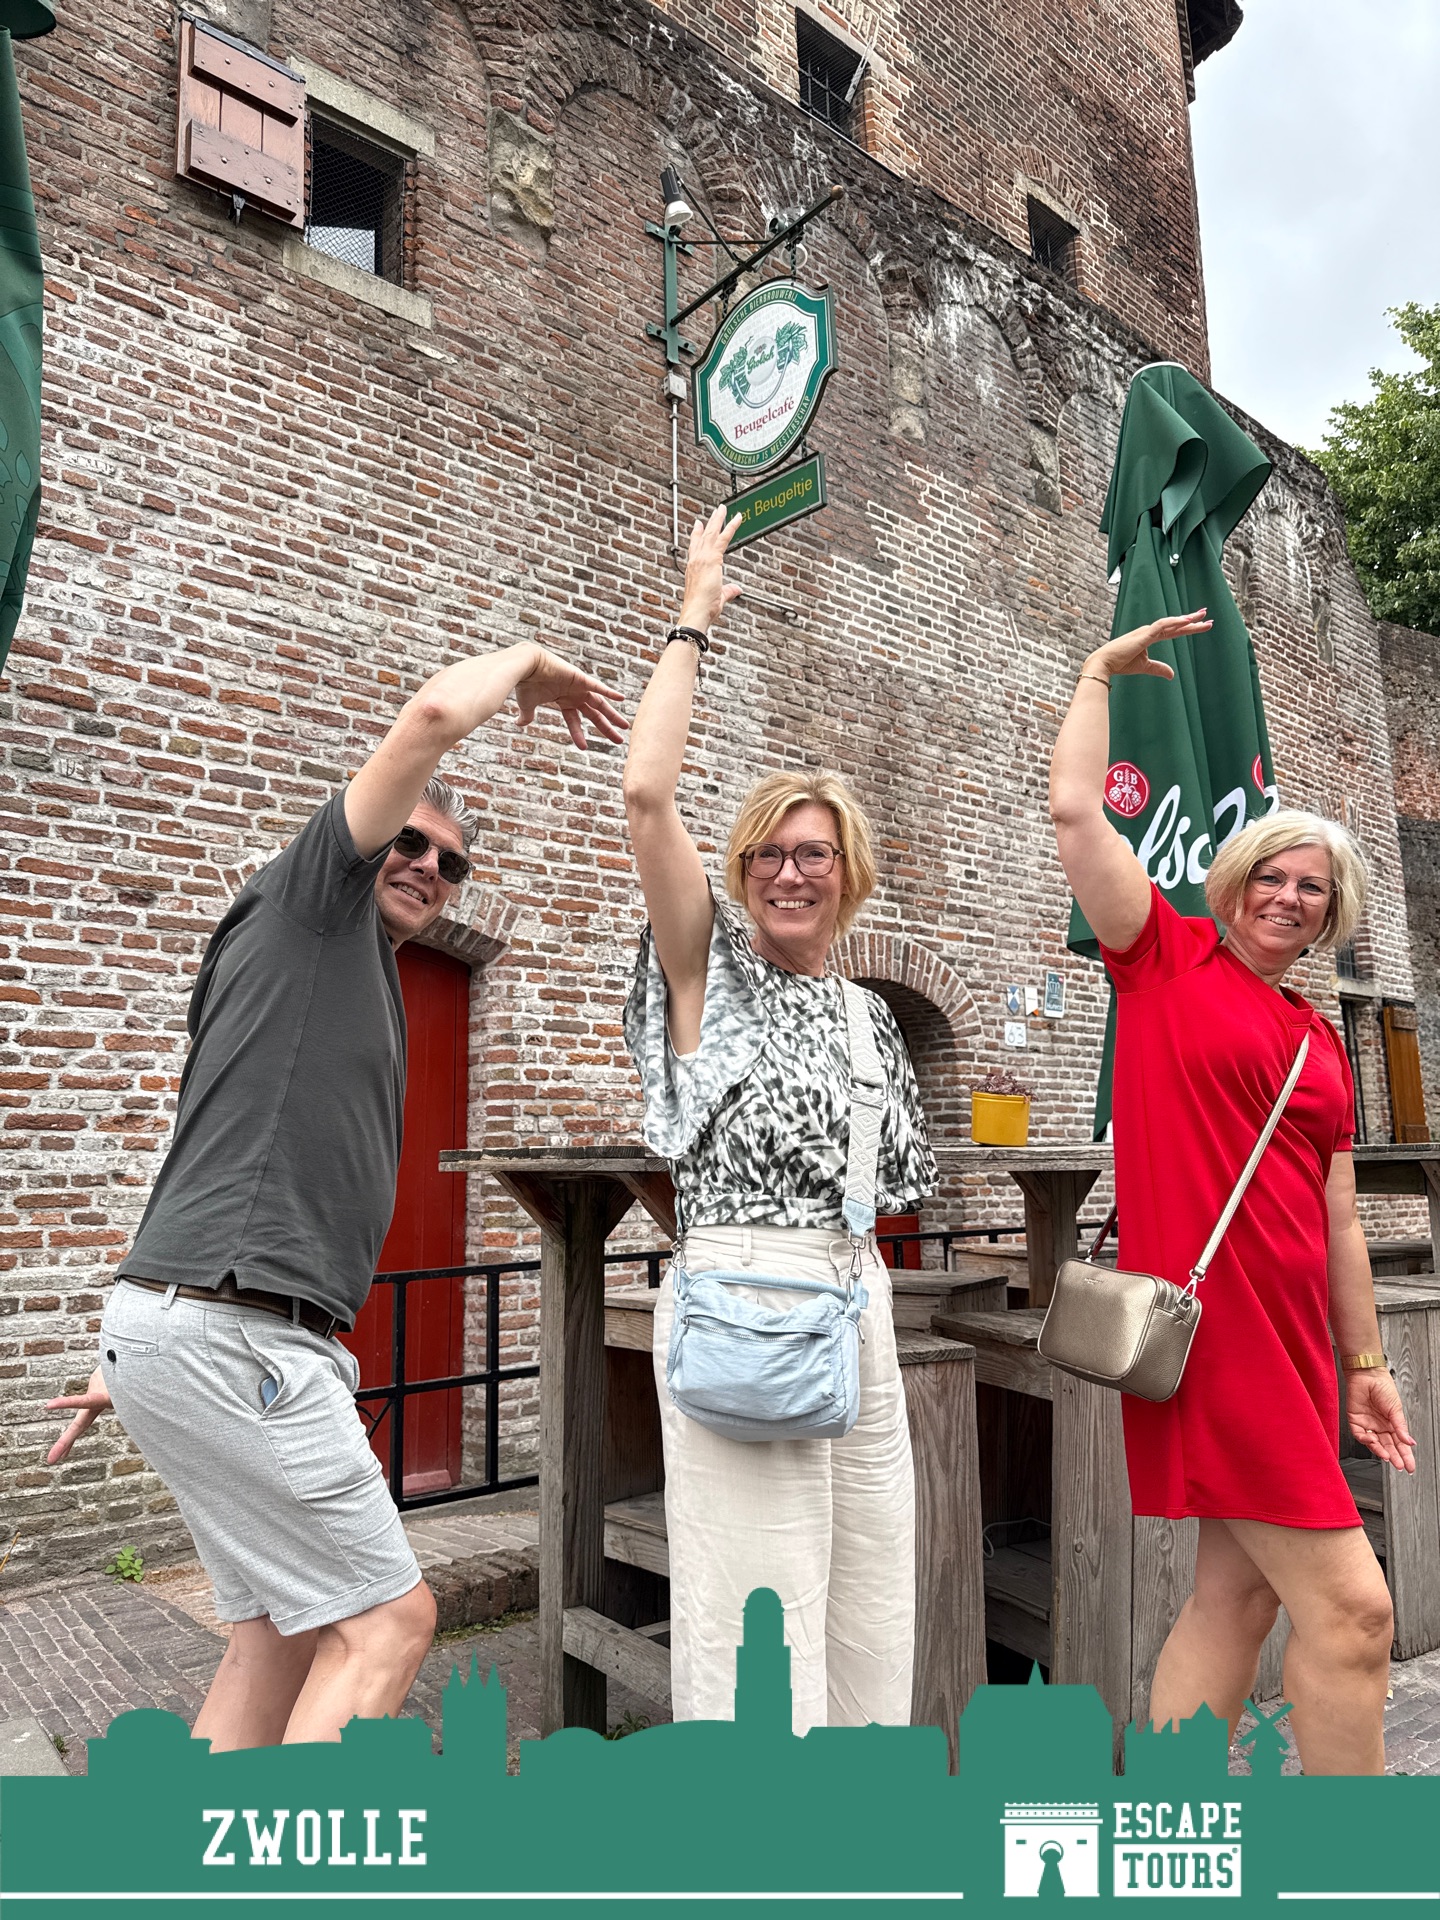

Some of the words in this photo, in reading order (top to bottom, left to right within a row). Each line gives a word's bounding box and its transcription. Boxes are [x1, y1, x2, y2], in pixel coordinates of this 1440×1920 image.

[721, 308, 748, 345] GROLSCHE
[749, 289, 799, 311] BIERBROUWERIJ
[747, 345, 774, 374] Grolsch
[720, 442, 760, 465] VAKMANSCHAP
[762, 450, 769, 459] IS
[770, 396, 811, 455] MEESTERSCHAP
[734, 396, 795, 440] Beugelcafé
[730, 507, 752, 524] et
[755, 478, 813, 516] Beugeltje
[1007, 1025, 1025, 1045] 63
